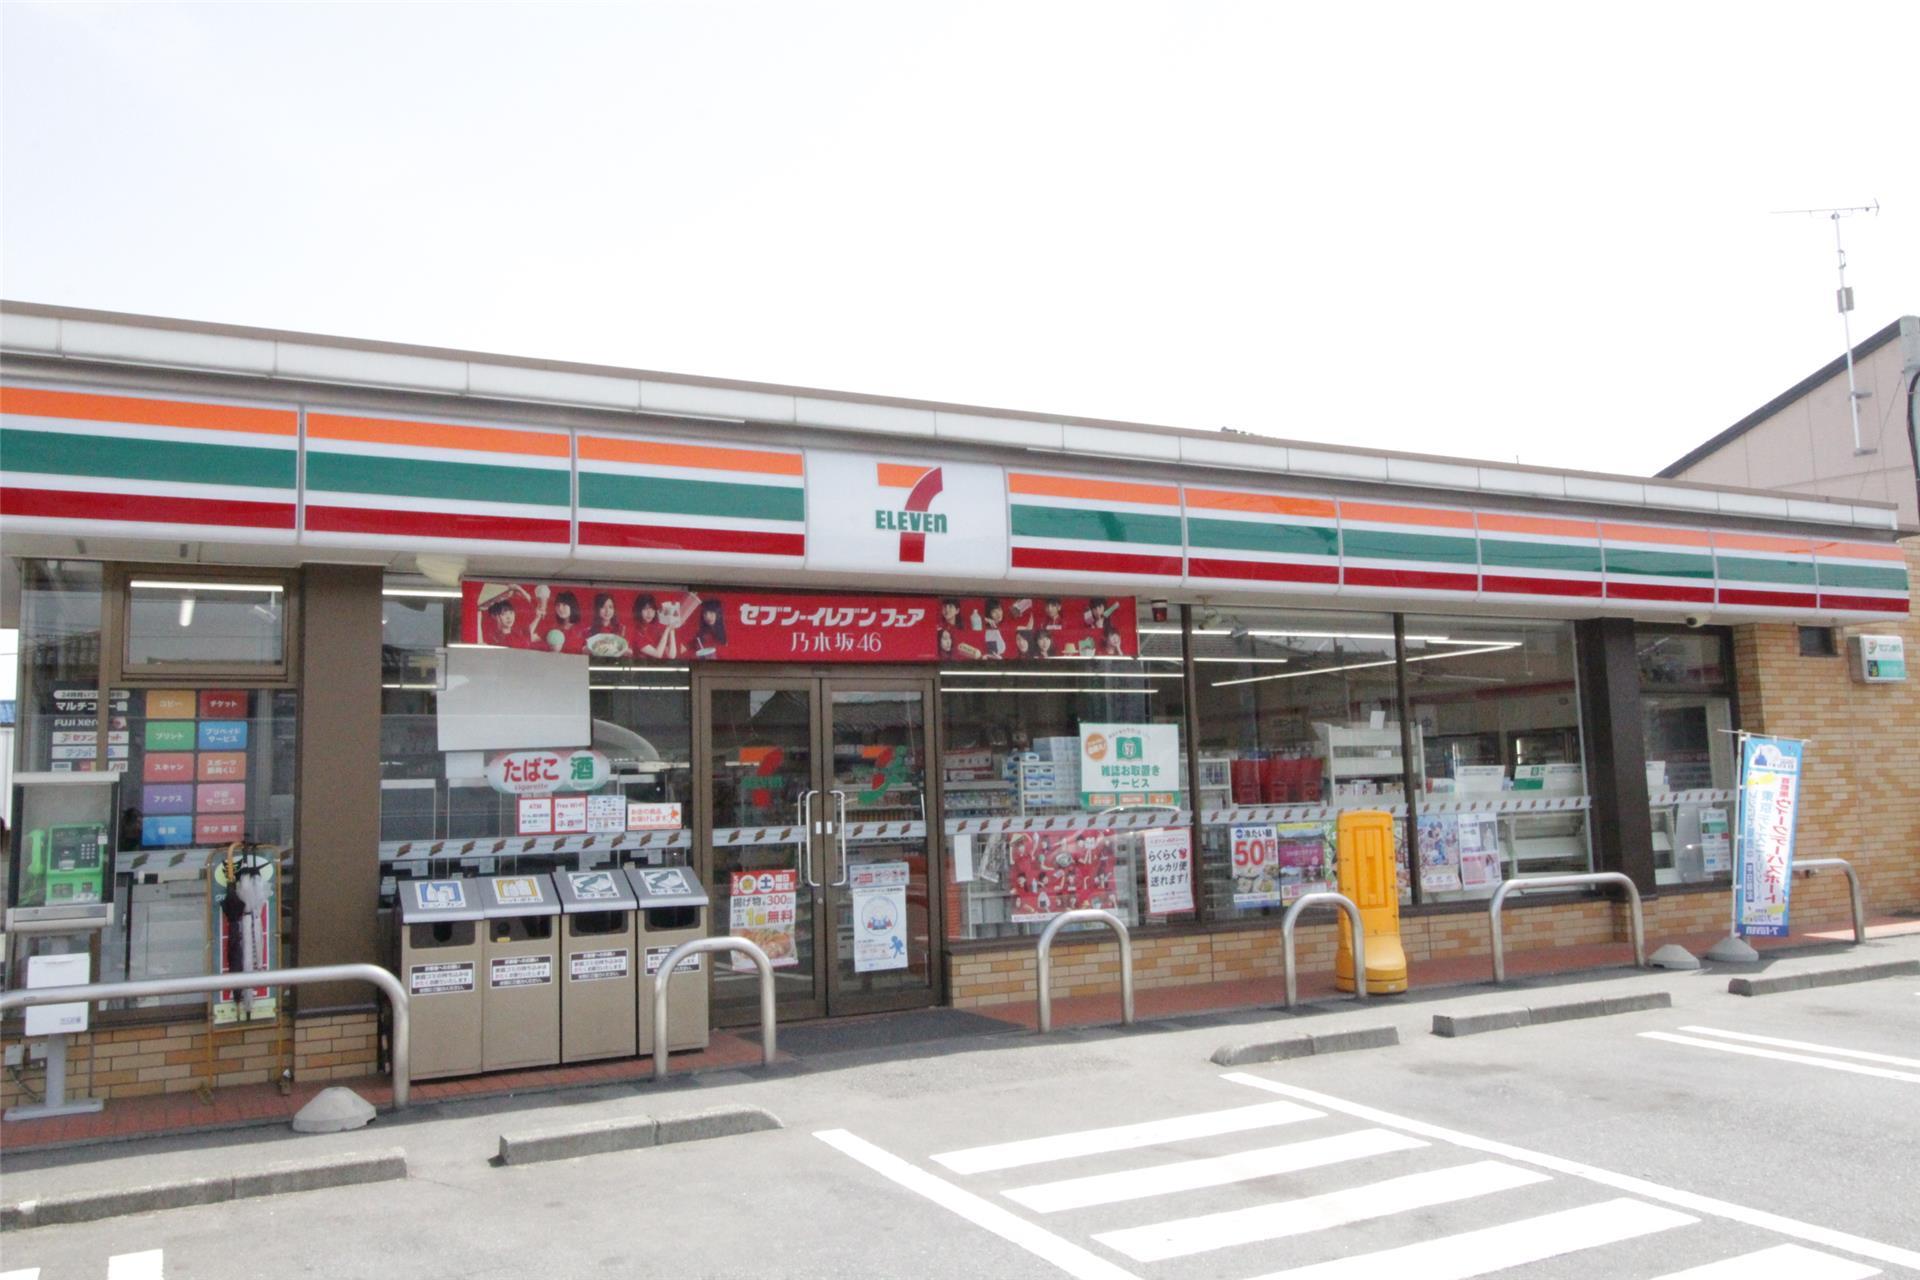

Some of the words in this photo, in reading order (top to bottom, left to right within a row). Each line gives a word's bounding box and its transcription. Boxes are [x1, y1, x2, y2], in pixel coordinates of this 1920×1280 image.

[880, 608, 925, 627] フェア
[791, 632, 882, 652] 乃木坂46
[56, 701, 128, 711] マルチコー機
[209, 700, 238, 708] チケット
[155, 732, 184, 740] プリント
[207, 735, 238, 743] サービス
[504, 758, 559, 782] たばこ
[571, 756, 594, 780] 酒
[1111, 778, 1150, 789] サービス
[153, 795, 183, 803] ファクス
[1149, 849, 1177, 861] らくらく
[1150, 861, 1187, 873] メルカリ便
[760, 876, 771, 889] 土
